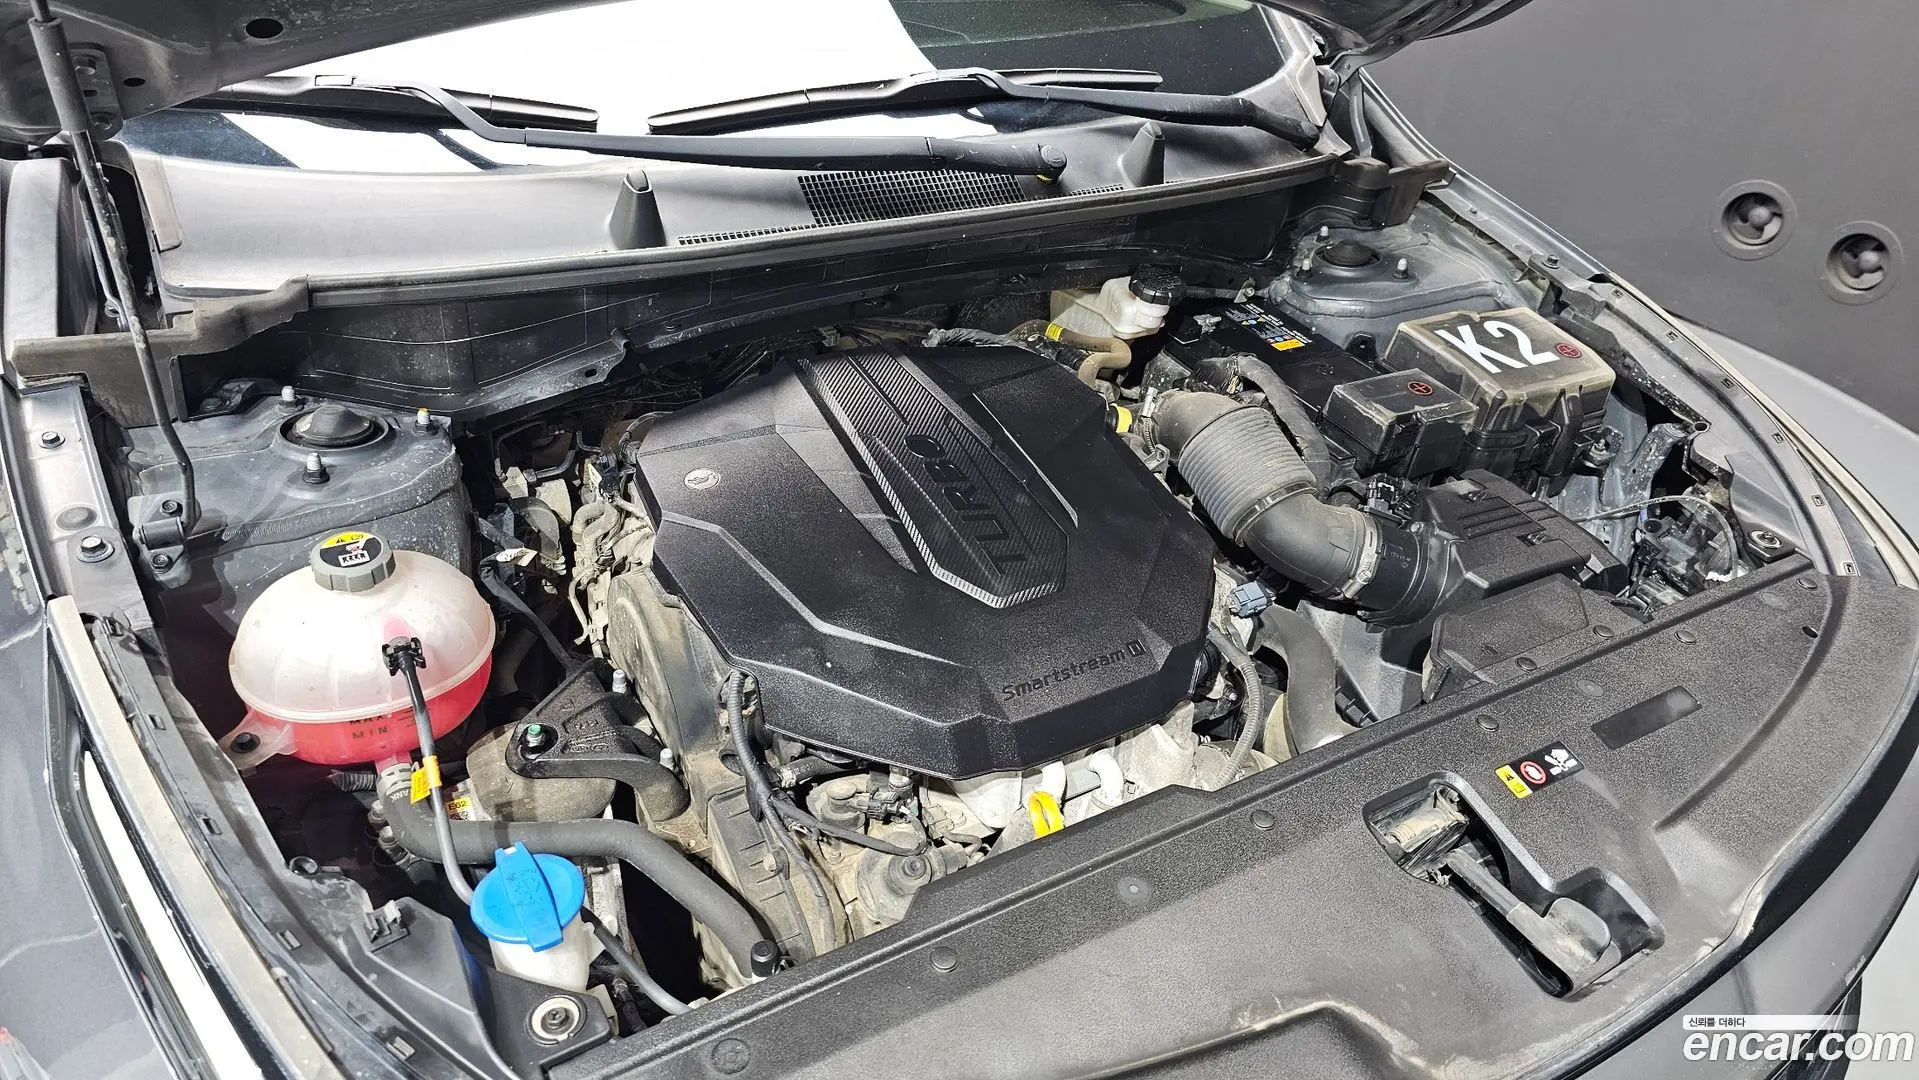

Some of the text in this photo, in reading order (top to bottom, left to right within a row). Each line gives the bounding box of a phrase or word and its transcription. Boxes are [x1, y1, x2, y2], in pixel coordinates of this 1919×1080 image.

[1434, 320, 1560, 374] K2
[903, 434, 1027, 577] TURBO
[1002, 650, 1126, 701] Smartstream
[351, 725, 388, 740] MIN
[389, 788, 410, 803] ANK
